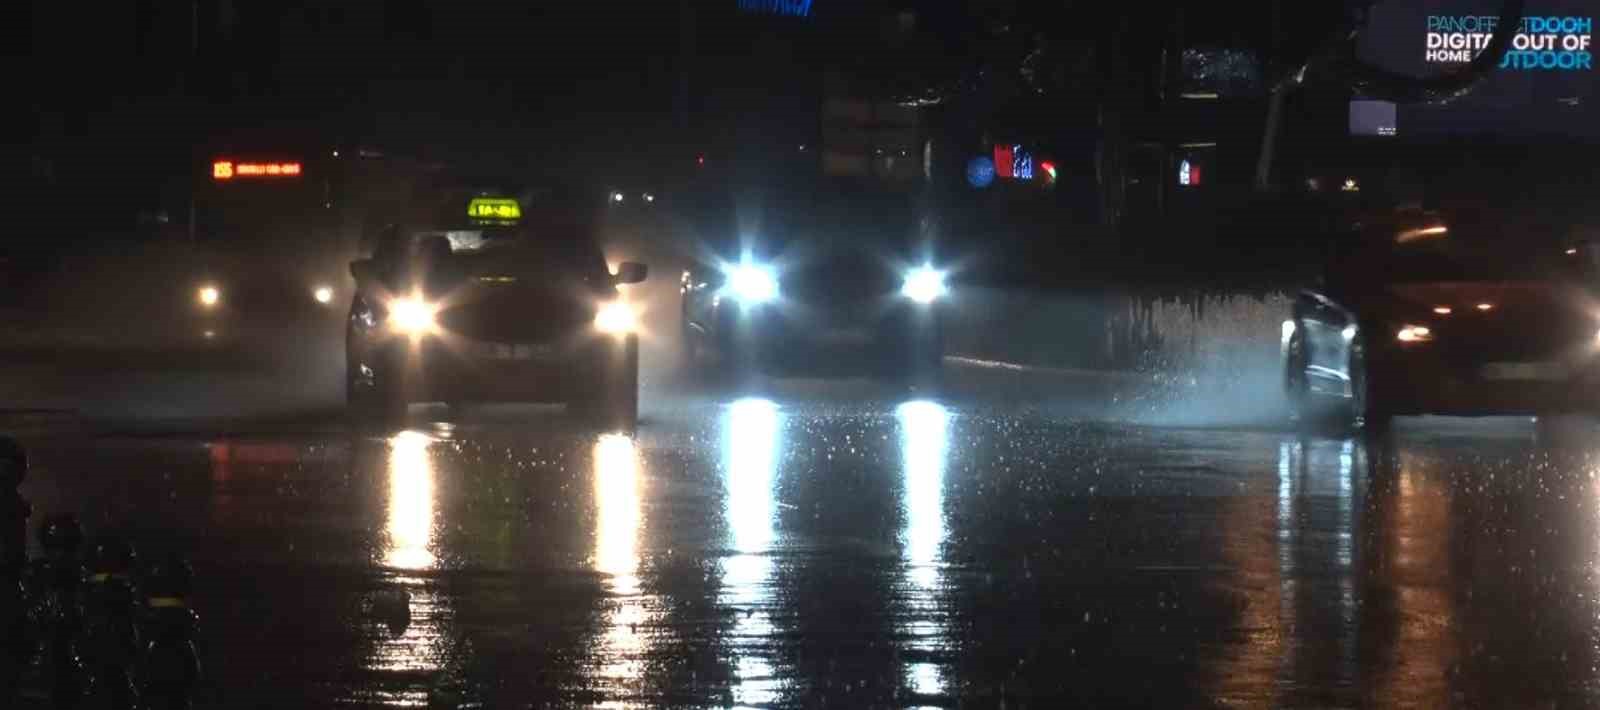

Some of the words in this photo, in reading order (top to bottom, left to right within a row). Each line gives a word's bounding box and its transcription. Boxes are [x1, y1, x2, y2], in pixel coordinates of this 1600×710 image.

[1513, 34, 1557, 50] OUT
[1562, 34, 1591, 50] OF
[1426, 50, 1472, 62] HOME
